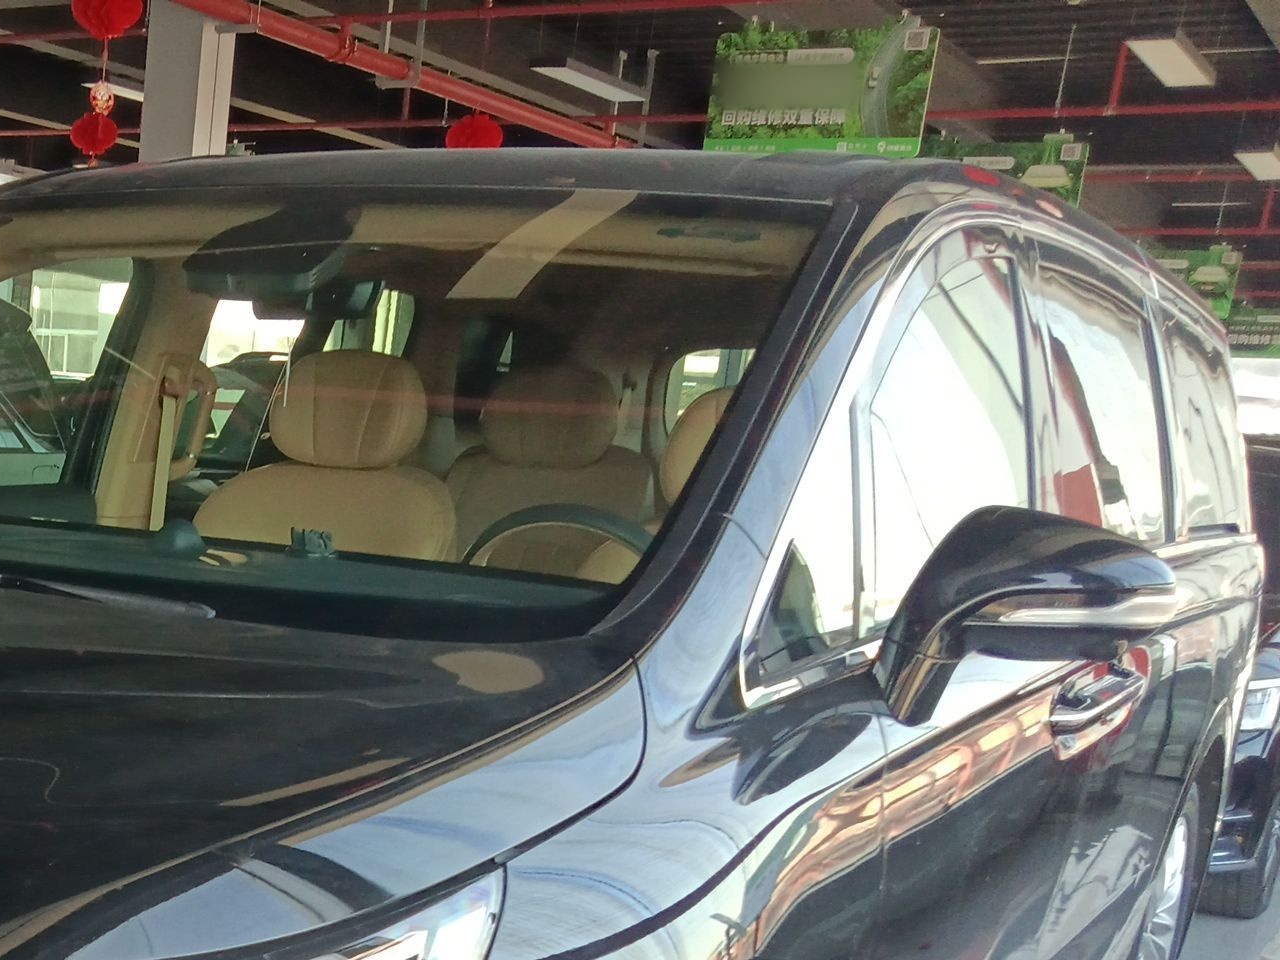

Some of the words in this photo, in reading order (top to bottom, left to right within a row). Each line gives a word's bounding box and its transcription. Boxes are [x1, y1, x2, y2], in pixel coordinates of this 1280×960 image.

[721, 107, 846, 126] 回购维修双重保障
